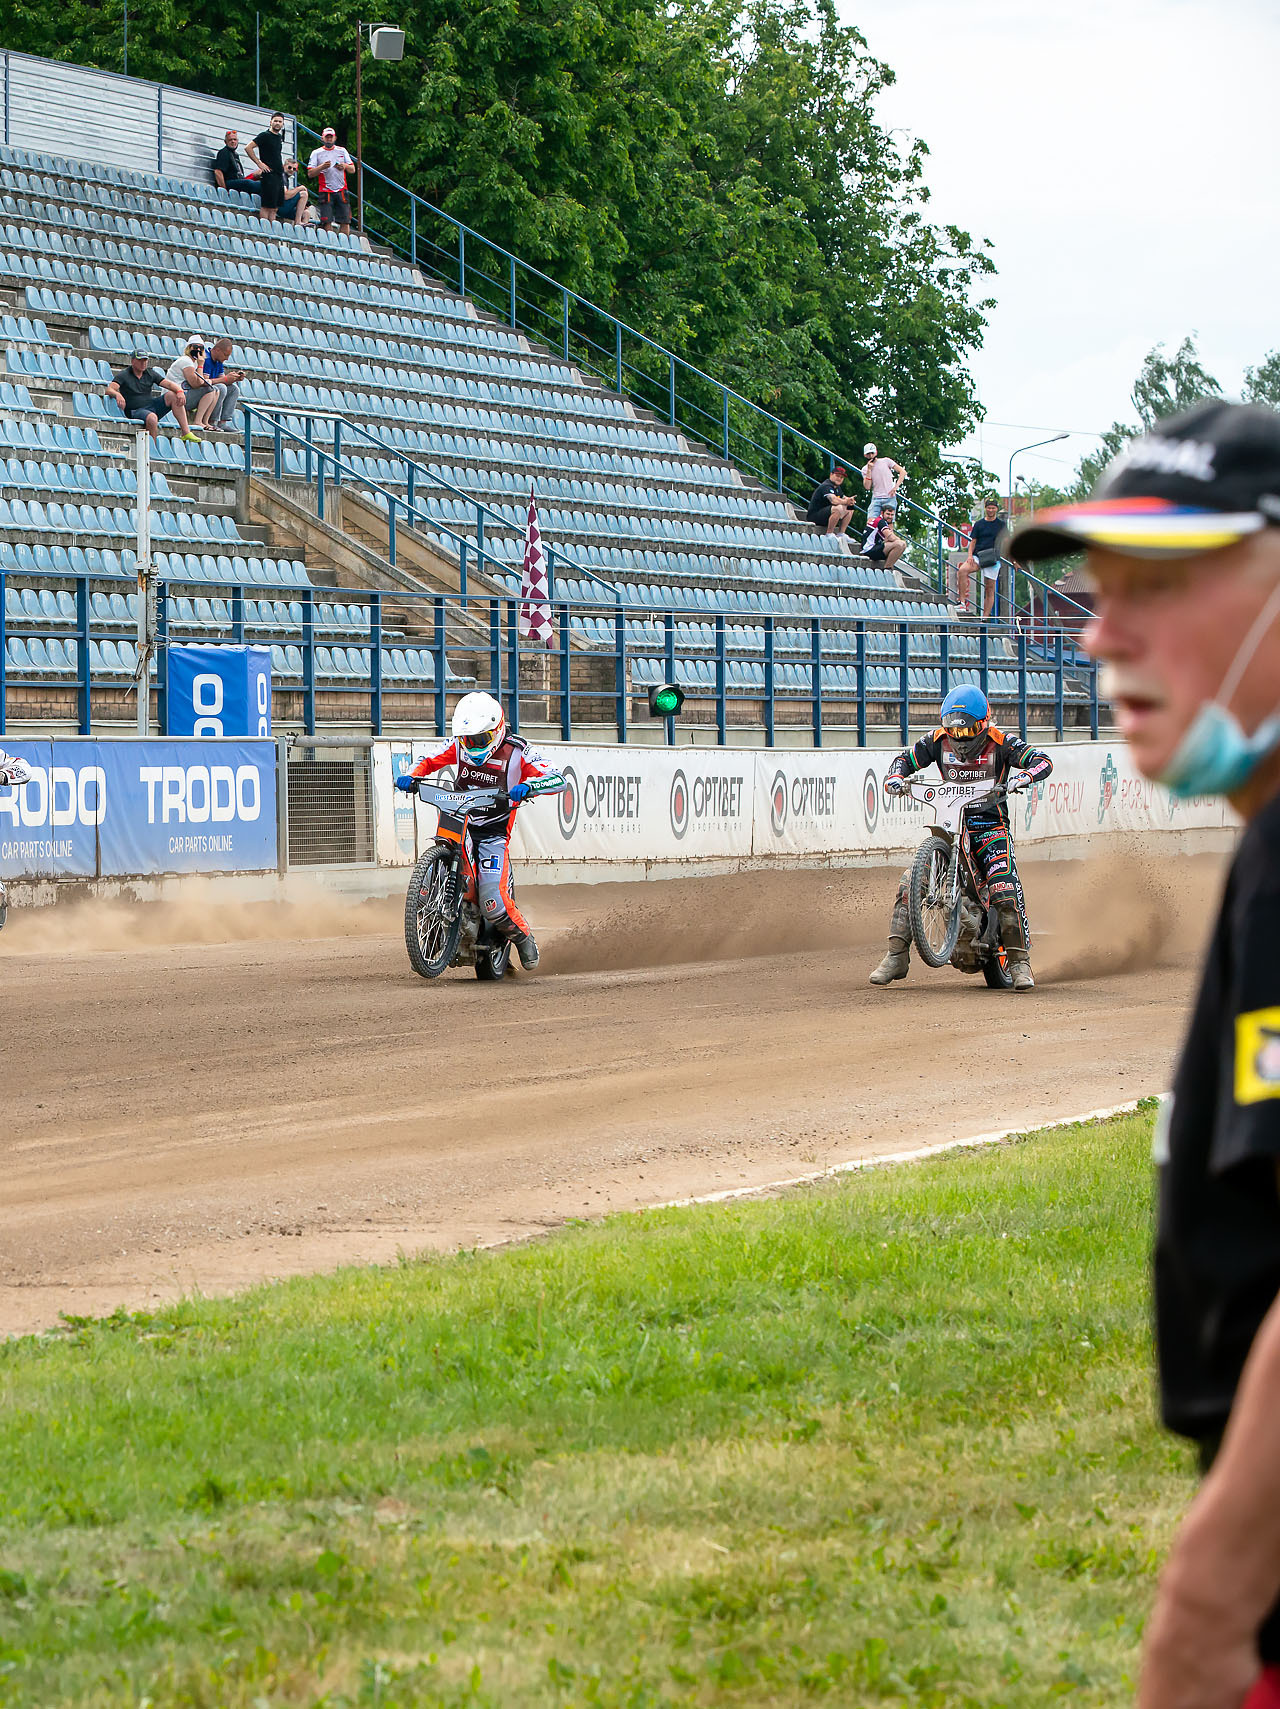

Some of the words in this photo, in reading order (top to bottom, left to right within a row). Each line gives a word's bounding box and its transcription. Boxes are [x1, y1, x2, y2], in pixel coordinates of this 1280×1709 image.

[470, 770, 498, 784] OPTIBET
[959, 770, 987, 778] OPTIBET
[140, 765, 261, 824] TRODO
[584, 774, 641, 818] OPTIBET
[693, 776, 743, 817] OPTIBET
[792, 776, 836, 816] OPTIBET
[938, 786, 976, 796] OPTIBET
[1049, 782, 1085, 815] PCR.LV
[2, 841, 19, 860] CAR
[20, 840, 44, 859] PARTS
[46, 840, 72, 858] ONLINE
[169, 837, 183, 853] CAR
[185, 836, 207, 853] PARTS
[208, 835, 232, 852] ONLINE
